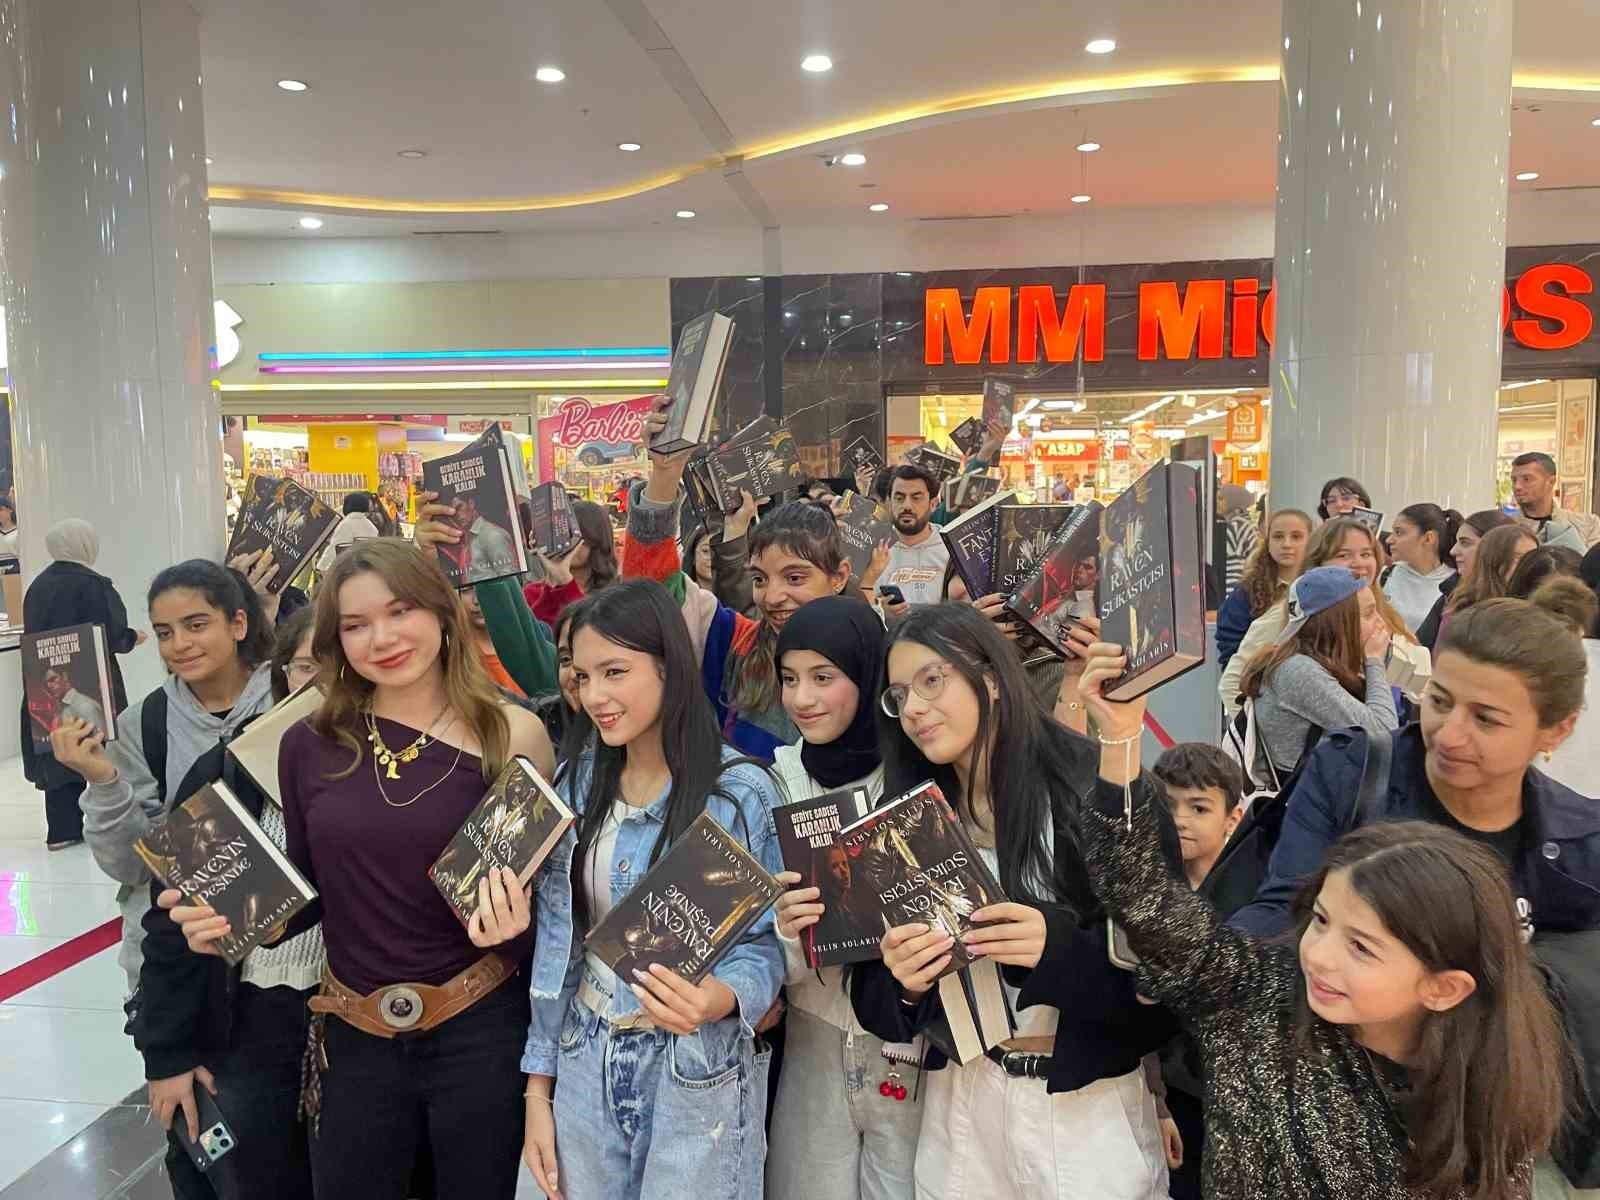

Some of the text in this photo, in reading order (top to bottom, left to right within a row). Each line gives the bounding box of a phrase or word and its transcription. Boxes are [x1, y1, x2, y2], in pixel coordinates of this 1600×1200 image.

[925, 284, 1106, 365] MM
[560, 397, 643, 448] Barbie
[1110, 547, 1154, 592] RAVEN
[794, 815, 841, 839] KARANLIK
[809, 832, 833, 848] KALDI
[902, 875, 967, 918] RAVEN
